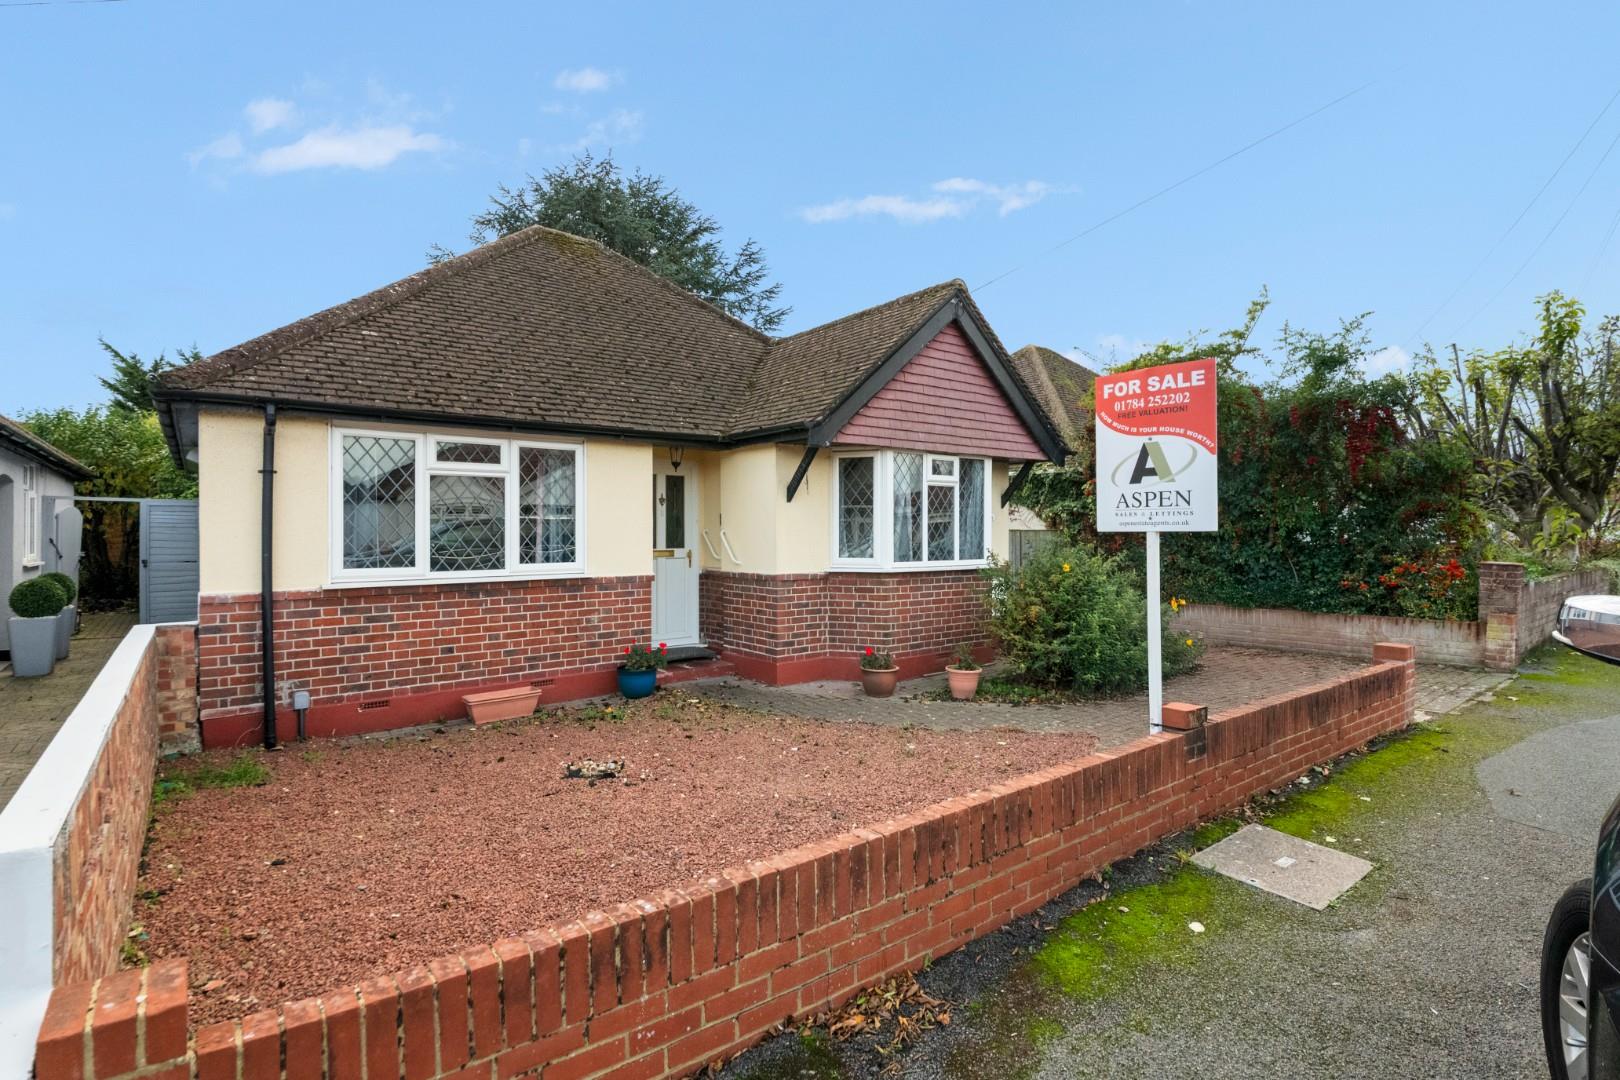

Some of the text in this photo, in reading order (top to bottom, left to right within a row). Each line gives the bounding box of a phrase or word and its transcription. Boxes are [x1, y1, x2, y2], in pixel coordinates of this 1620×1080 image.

[1103, 370, 1205, 399] FOR SALE
[1114, 392, 1190, 411] 01784 252202
[1117, 405, 1188, 419] FREE VALUATION!
[1100, 411, 1112, 424] HOW
[1112, 422, 1129, 432] MUCH
[1159, 426, 1185, 434] HOUSE
[1186, 430, 1215, 448] WORTH?
[1115, 489, 1192, 509] ASPEN
